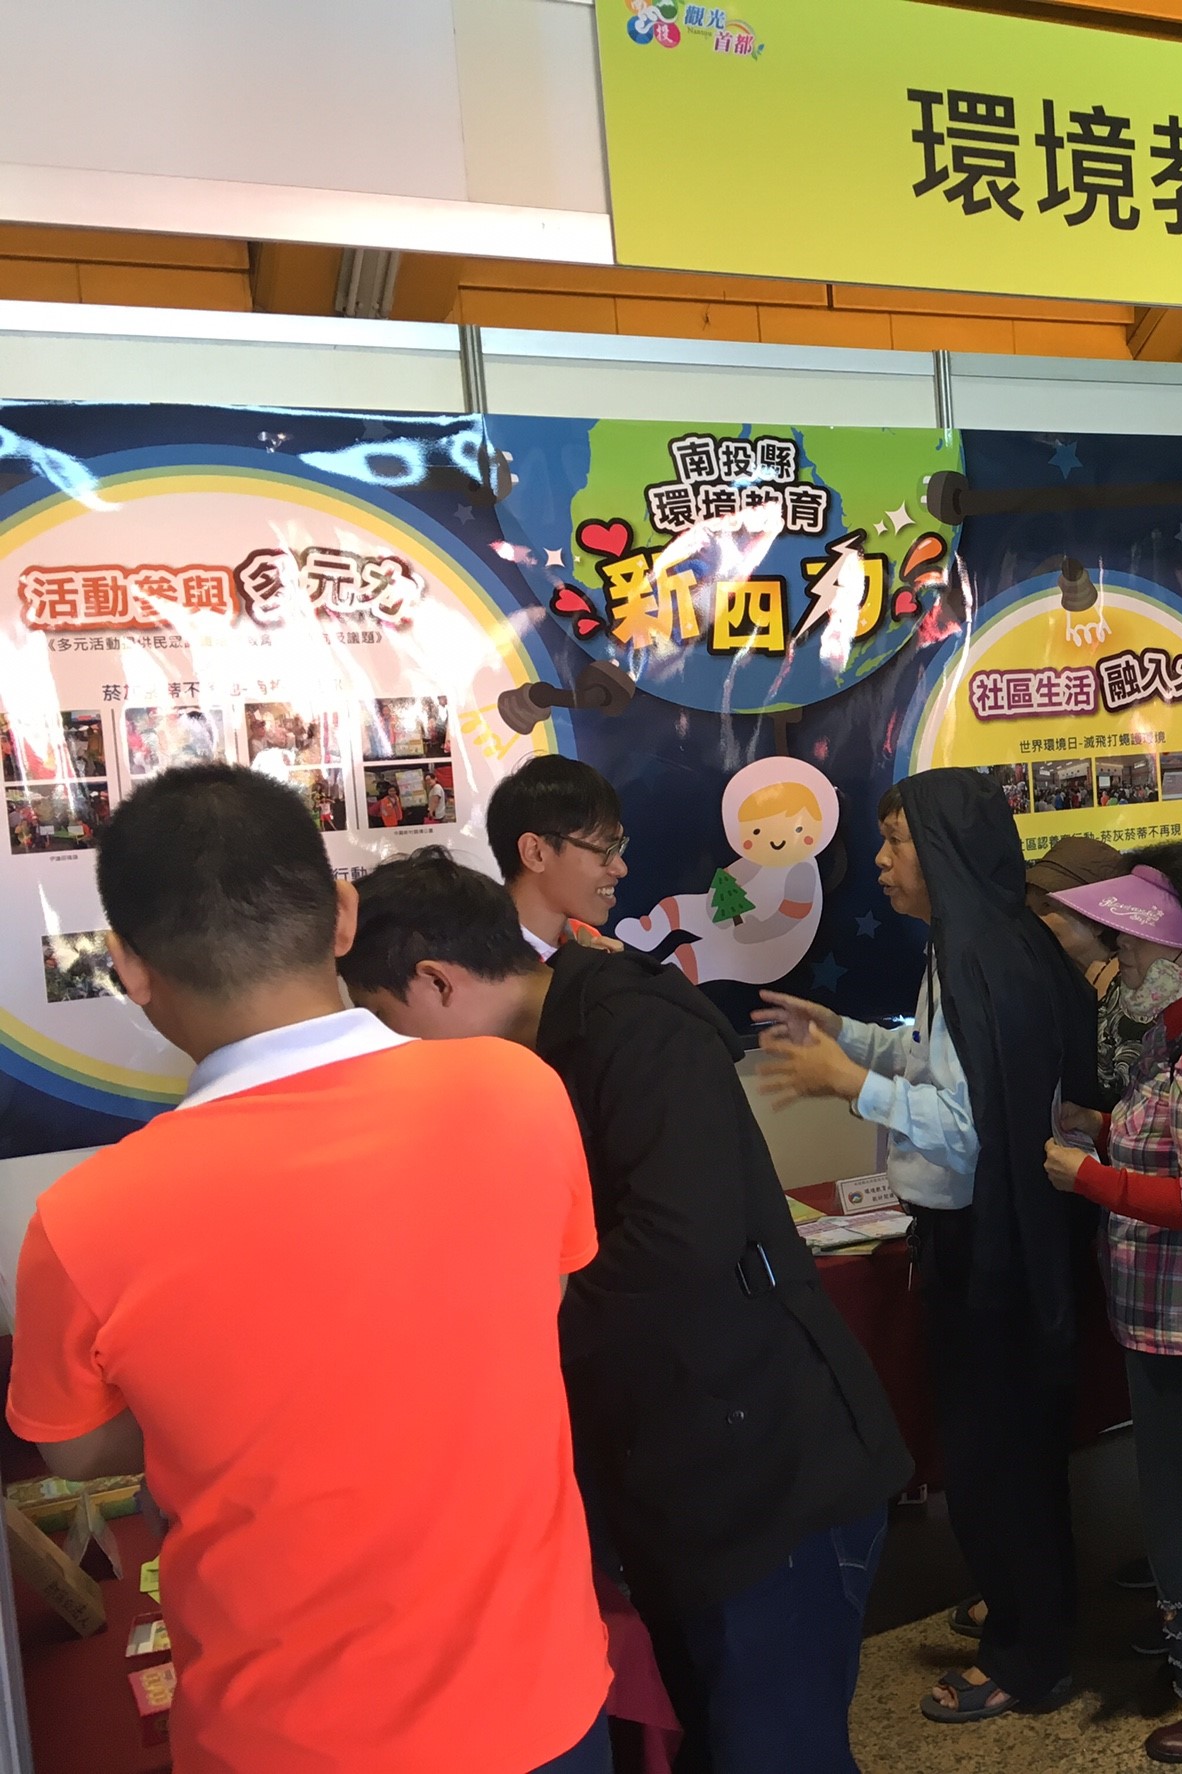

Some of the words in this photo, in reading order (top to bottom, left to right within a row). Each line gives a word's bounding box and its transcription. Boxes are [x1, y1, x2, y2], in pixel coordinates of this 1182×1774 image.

[685, 5, 725, 29] 觀光
[714, 32, 754, 55] 首都
[676, 441, 792, 481] 南投縣
[31, 573, 229, 620] 活動參與
[601, 539, 885, 652] 新四力
[975, 671, 1094, 713] 社區生活
